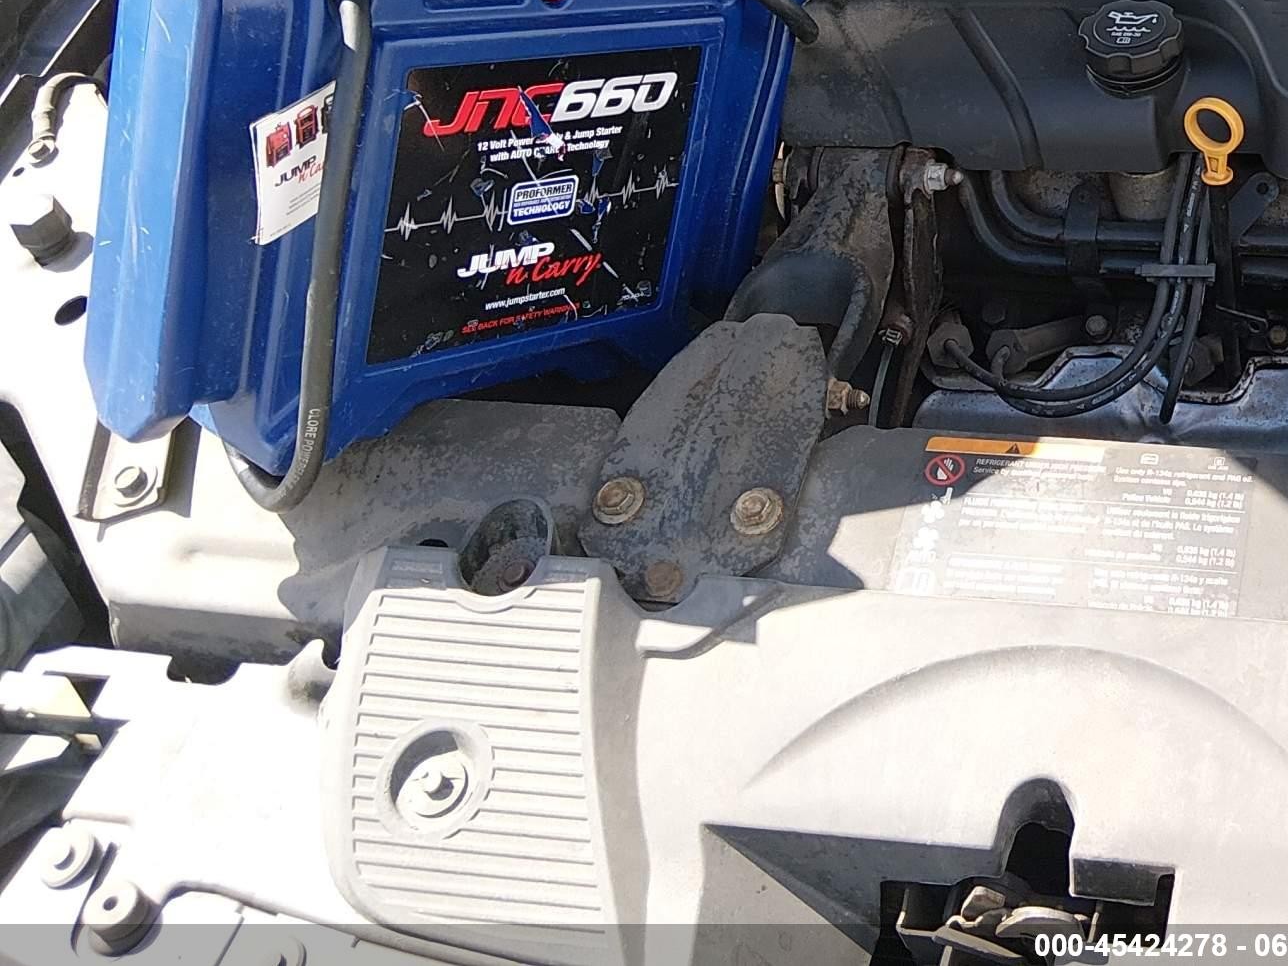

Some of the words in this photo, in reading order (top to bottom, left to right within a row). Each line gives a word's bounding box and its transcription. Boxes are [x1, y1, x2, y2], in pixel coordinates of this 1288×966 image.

[477, 140, 490, 151] 12
[490, 138, 507, 151] Volt
[507, 136, 534, 150] Power
[565, 129, 572, 140] &
[573, 128, 595, 141] Jump
[595, 125, 623, 137] Starter
[490, 151, 509, 163] with
[510, 148, 532, 160] AUTO
[567, 138, 609, 153] Technology
[275, 154, 317, 187] JUMP
[516, 183, 573, 200] PROFORMER
[513, 199, 571, 218] TECHNOLOGY
[456, 241, 555, 278] JUMP
[531, 251, 603, 286] Carry
[485, 286, 566, 311] www.jumpstarter.com
[478, 318, 498, 332] BACK
[499, 315, 514, 326] FOR
[304, 408, 321, 439] CLORE
[973, 466, 999, 475] Service
[976, 458, 1025, 468] REFRIGERANT
